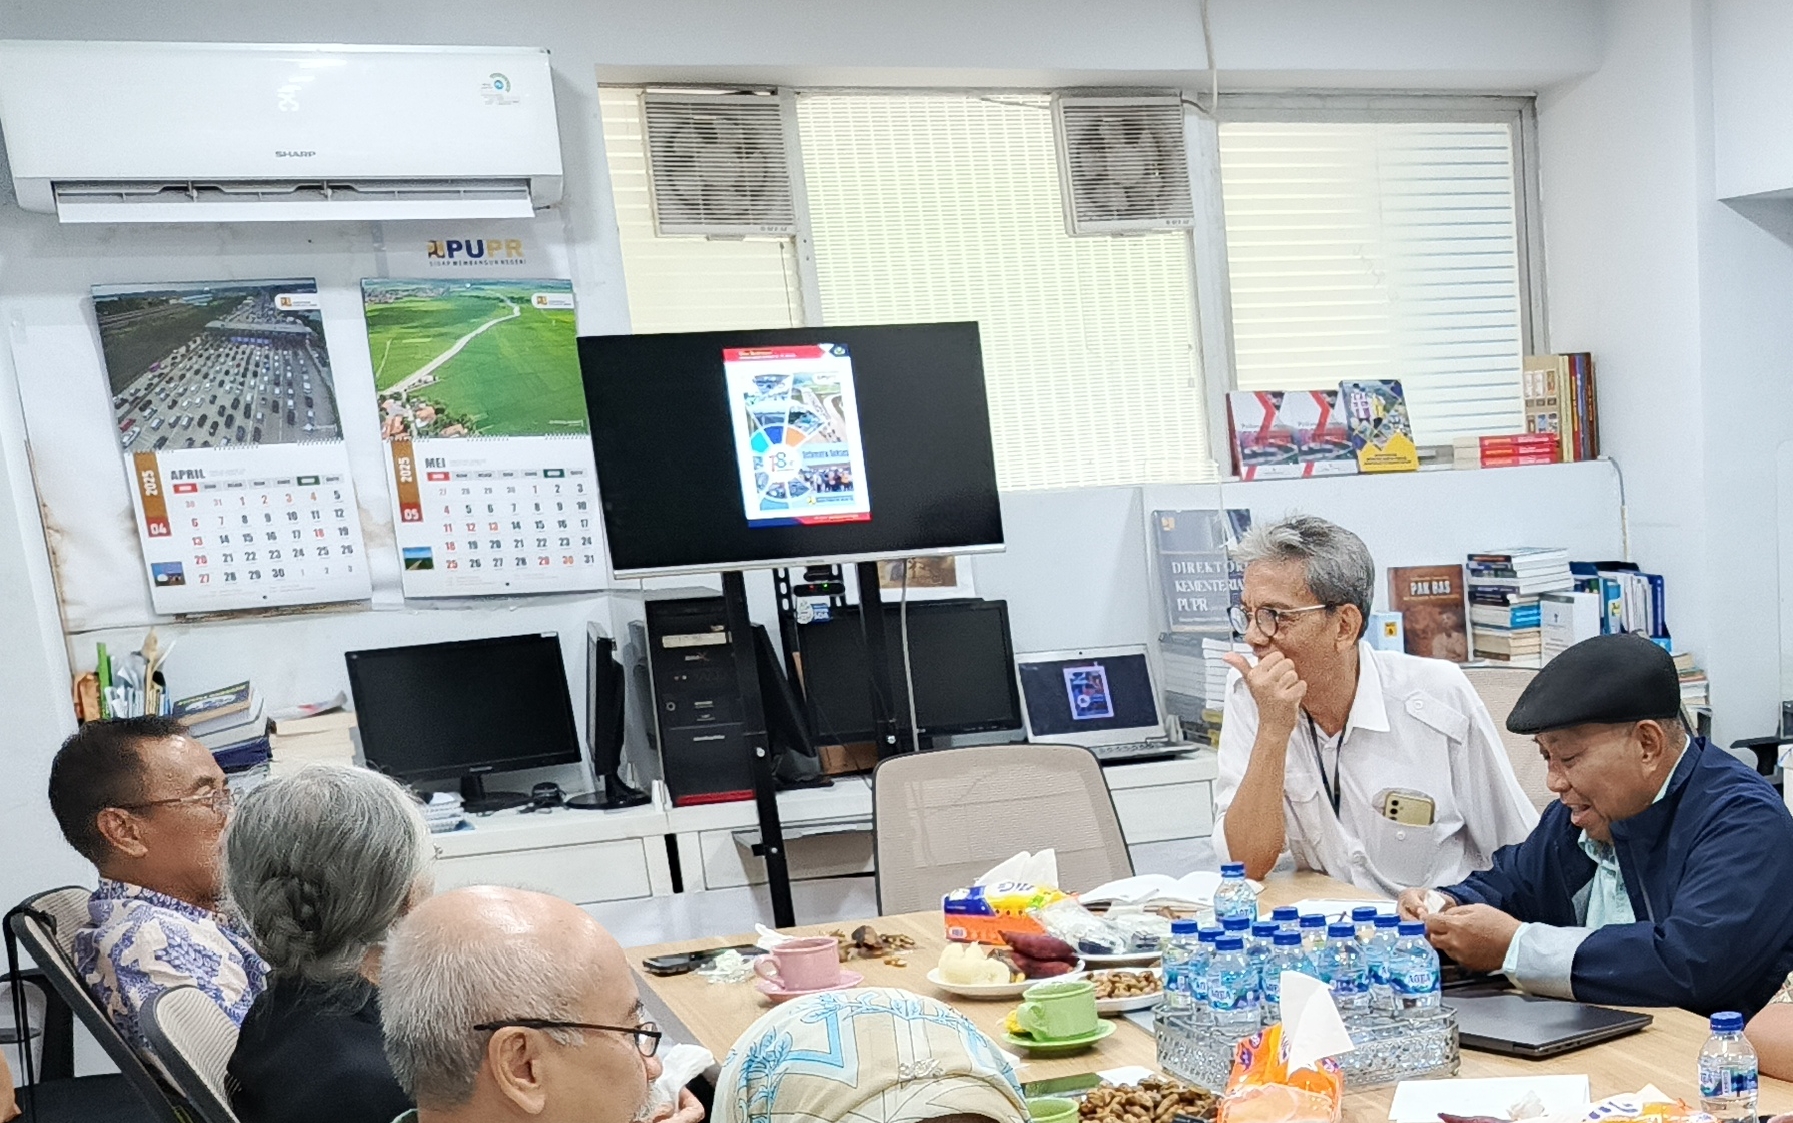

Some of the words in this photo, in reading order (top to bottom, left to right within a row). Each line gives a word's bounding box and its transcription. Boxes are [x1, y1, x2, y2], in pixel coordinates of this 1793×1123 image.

[446, 239, 525, 258] PUPR
[399, 457, 413, 483] 2025
[425, 457, 446, 468] MEI
[170, 468, 206, 480] APRIL
[142, 470, 157, 496] 2025
[532, 485, 537, 494] 1
[554, 484, 560, 494] 2
[577, 483, 584, 493] 3
[239, 496, 245, 506] 1
[261, 494, 267, 505] 2
[285, 493, 292, 503] 3
[310, 491, 317, 501] 4
[333, 490, 341, 500] 5
[404, 508, 419, 520] 05
[444, 505, 450, 514] 4
[465, 504, 472, 514] 5
[487, 504, 494, 513] 6
[511, 503, 516, 513] 7
[534, 502, 541, 512] 8
[556, 502, 563, 511] 9
[576, 501, 587, 510] 10
[191, 518, 199, 528] 6
[218, 516, 224, 526] 7
[241, 514, 248, 524] 8
[264, 513, 272, 523] 9
[286, 511, 298, 521] 10
[310, 510, 320, 520] 11
[334, 508, 345, 518] 12
[443, 523, 453, 533] 11
[465, 522, 476, 532] 12
[488, 521, 498, 531] 13
[511, 521, 521, 530] 14
[534, 520, 545, 530] 15
[557, 519, 568, 529] 16
[580, 518, 589, 528] 17
[150, 523, 167, 535] 04
[192, 536, 203, 546] 13
[219, 534, 230, 544] 14
[242, 533, 254, 543] 15
[266, 531, 277, 541] 16
[292, 529, 301, 539] 17
[313, 528, 325, 538] 18
[338, 526, 349, 536] 19
[445, 541, 456, 551] 18
[467, 540, 478, 550] 19
[489, 539, 502, 549] 20
[513, 539, 524, 549] 21
[536, 538, 547, 548] 22
[558, 537, 570, 547] 23
[581, 536, 592, 546] 24
[194, 555, 208, 565] 20
[222, 553, 234, 563] 21
[244, 551, 257, 562] 22
[268, 549, 282, 560] 23
[292, 548, 305, 558] 24
[316, 546, 329, 556] 25
[340, 544, 354, 555] 26
[446, 559, 458, 569] 25
[469, 558, 482, 568] 26
[492, 557, 503, 568] 27
[515, 557, 527, 567] 28
[538, 556, 550, 566] 29
[562, 555, 574, 565] 30
[584, 554, 595, 564] 31
[198, 573, 210, 584] 27
[224, 572, 237, 582] 28
[248, 570, 262, 580] 29
[271, 568, 285, 578] 30
[1175, 579, 1244, 592] KEMENTERIA
[1177, 598, 1208, 611] PUPR
